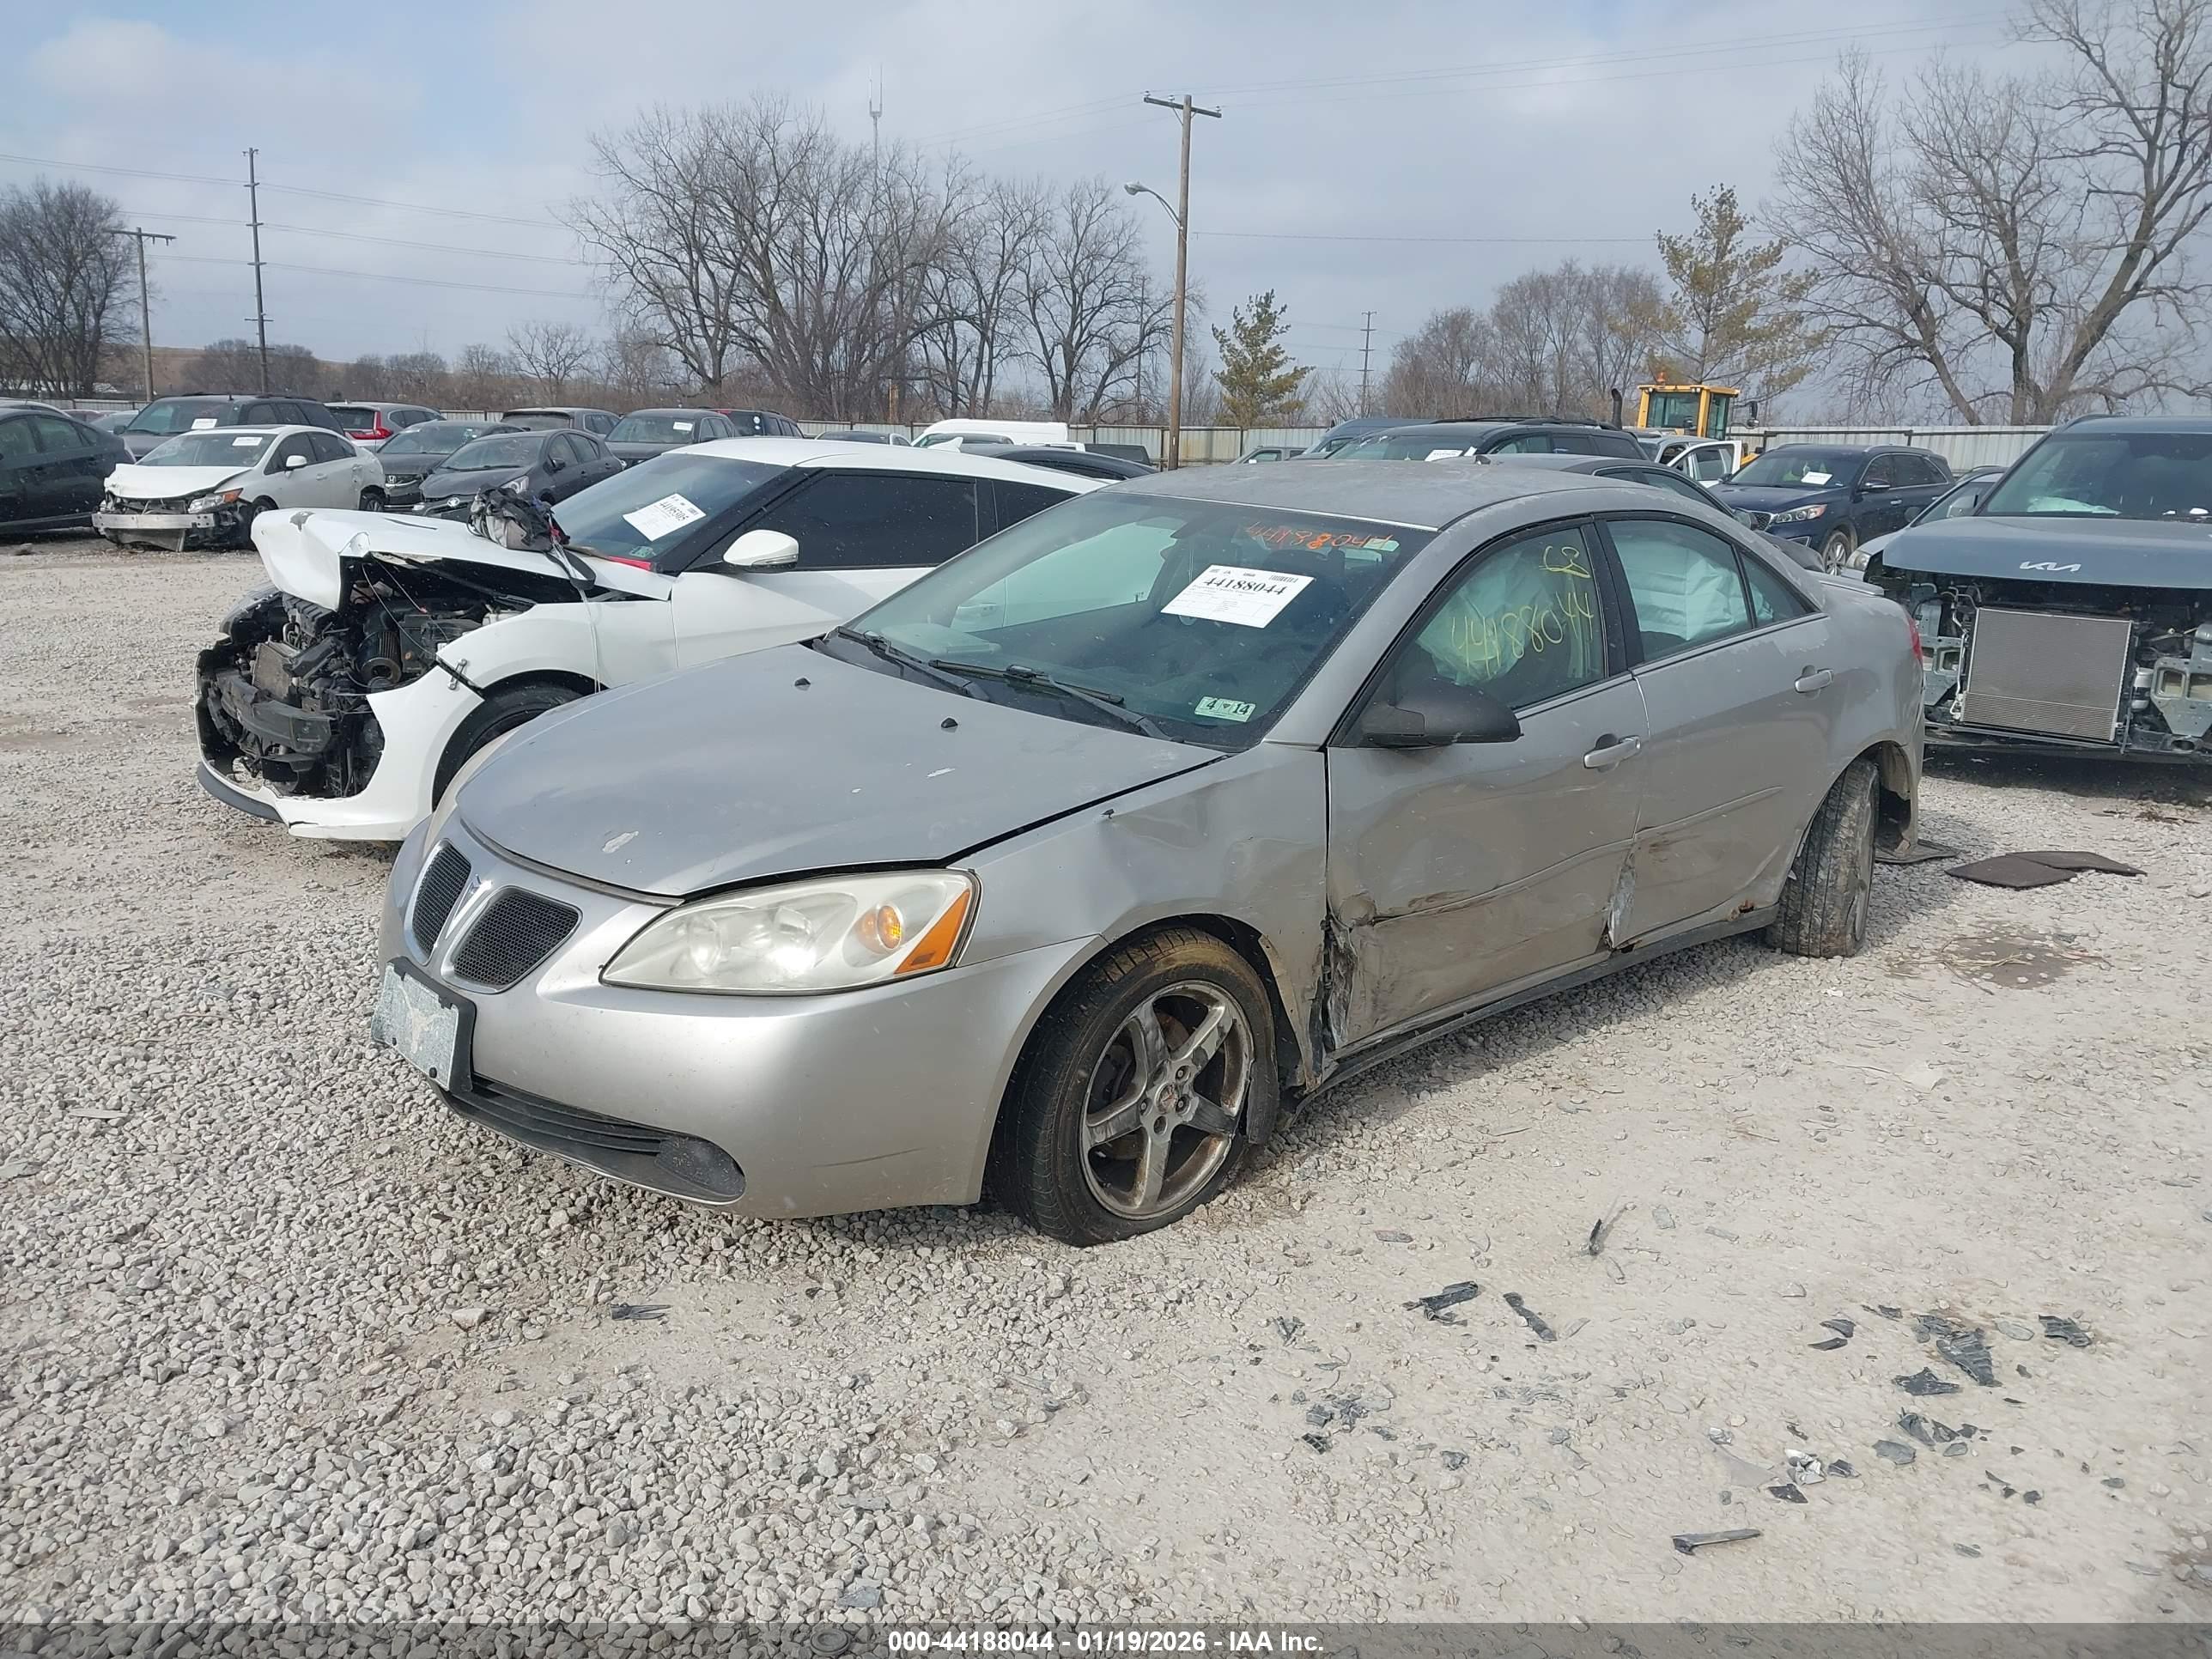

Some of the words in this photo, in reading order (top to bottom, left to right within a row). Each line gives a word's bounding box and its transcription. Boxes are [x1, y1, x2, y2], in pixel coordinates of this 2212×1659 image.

[1202, 577, 1287, 595] 44188044
[1451, 591, 1595, 678] 44188044
[1206, 699, 1218, 710] 4
[1232, 703, 1250, 715] 14
